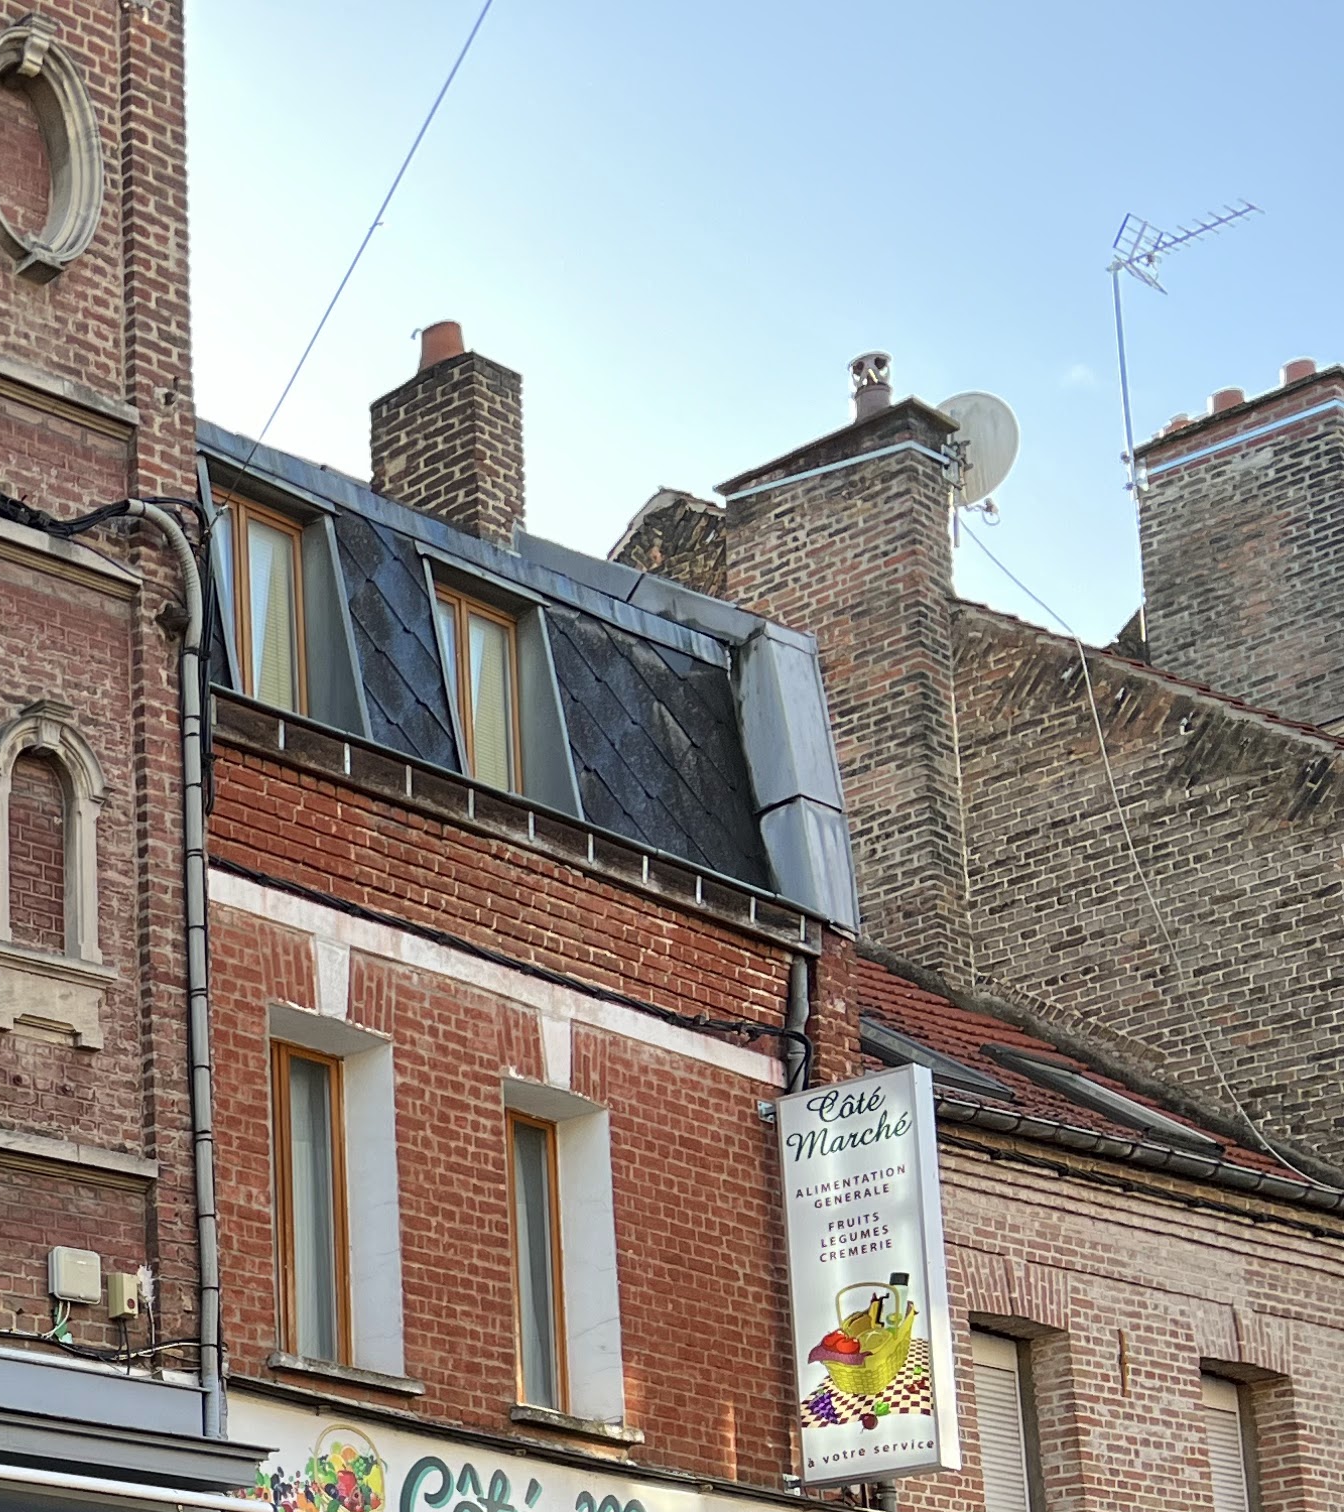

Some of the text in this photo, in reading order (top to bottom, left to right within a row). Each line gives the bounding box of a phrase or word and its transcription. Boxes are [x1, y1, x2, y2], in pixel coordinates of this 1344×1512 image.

[806, 1085, 886, 1123] Côté
[786, 1111, 912, 1163] Marché
[795, 1164, 907, 1199] ALIMENTATION
[814, 1183, 890, 1209] GENERALE
[828, 1212, 880, 1232] FRUITS
[820, 1225, 890, 1248] LEGUMES
[819, 1239, 893, 1263] CREMERIE
[822, 1445, 867, 1466] votre
[873, 1438, 935, 1455] service
